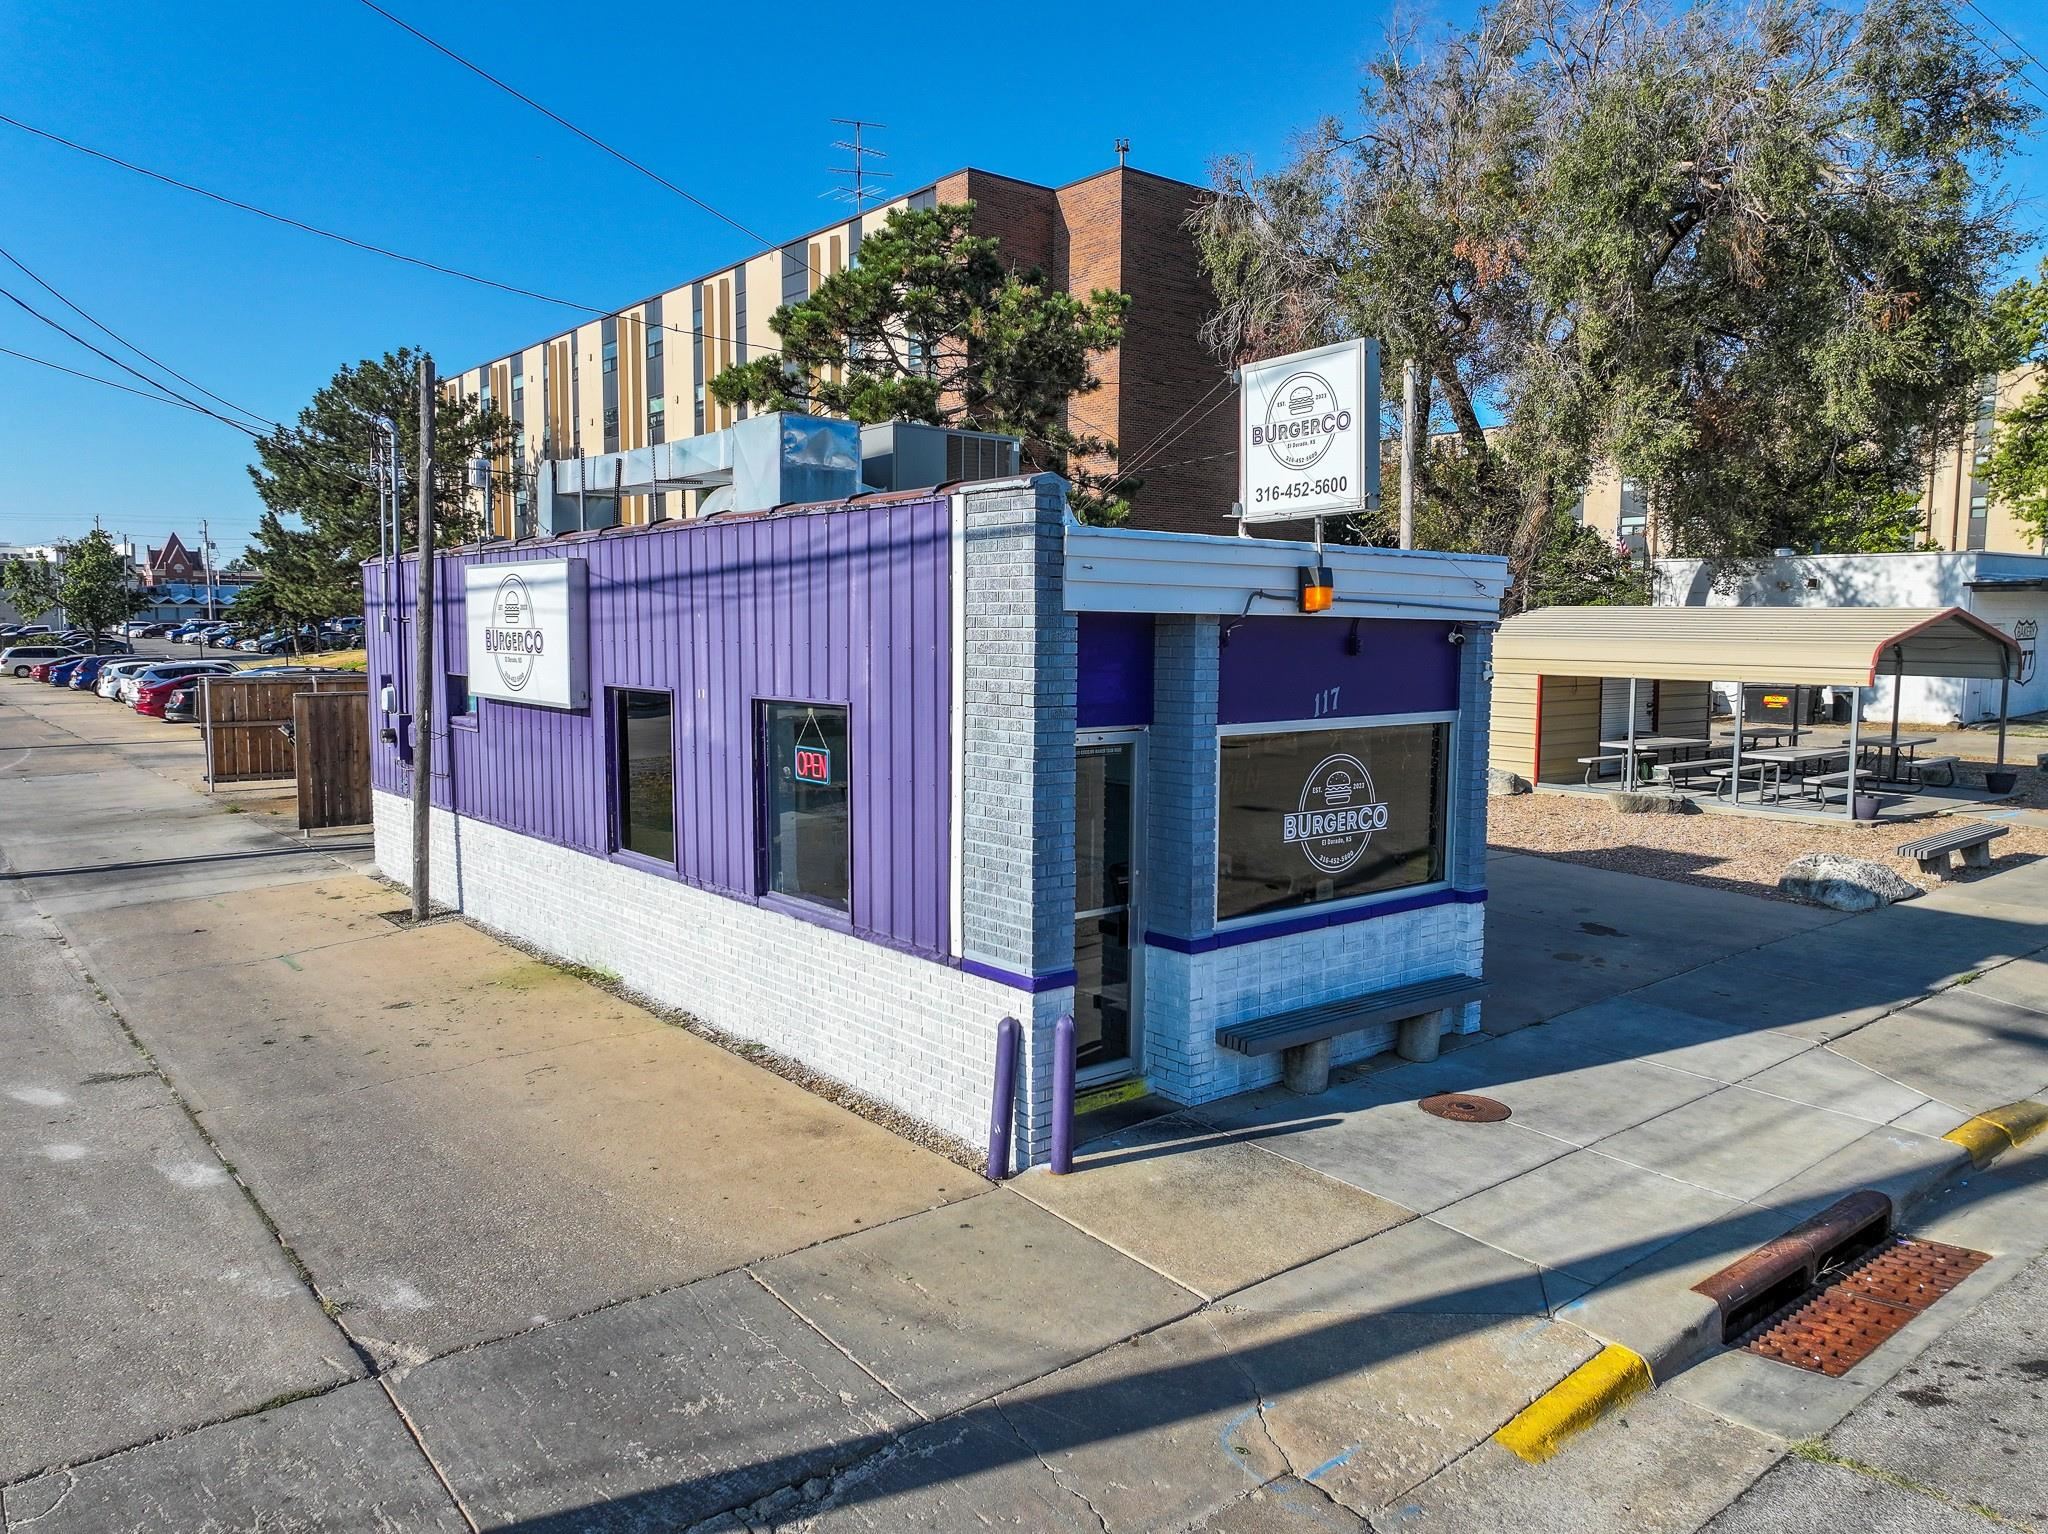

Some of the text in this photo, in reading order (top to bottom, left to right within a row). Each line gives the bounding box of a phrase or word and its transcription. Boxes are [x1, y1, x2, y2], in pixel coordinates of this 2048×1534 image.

[1252, 410, 1351, 446] BURGERCO
[1256, 476, 1347, 502] 316-452-5600
[486, 630, 544, 654] BURGERCO
[1314, 686, 1340, 717] 117
[797, 751, 827, 779] OPEN
[1284, 805, 1388, 840] BURGERCO
